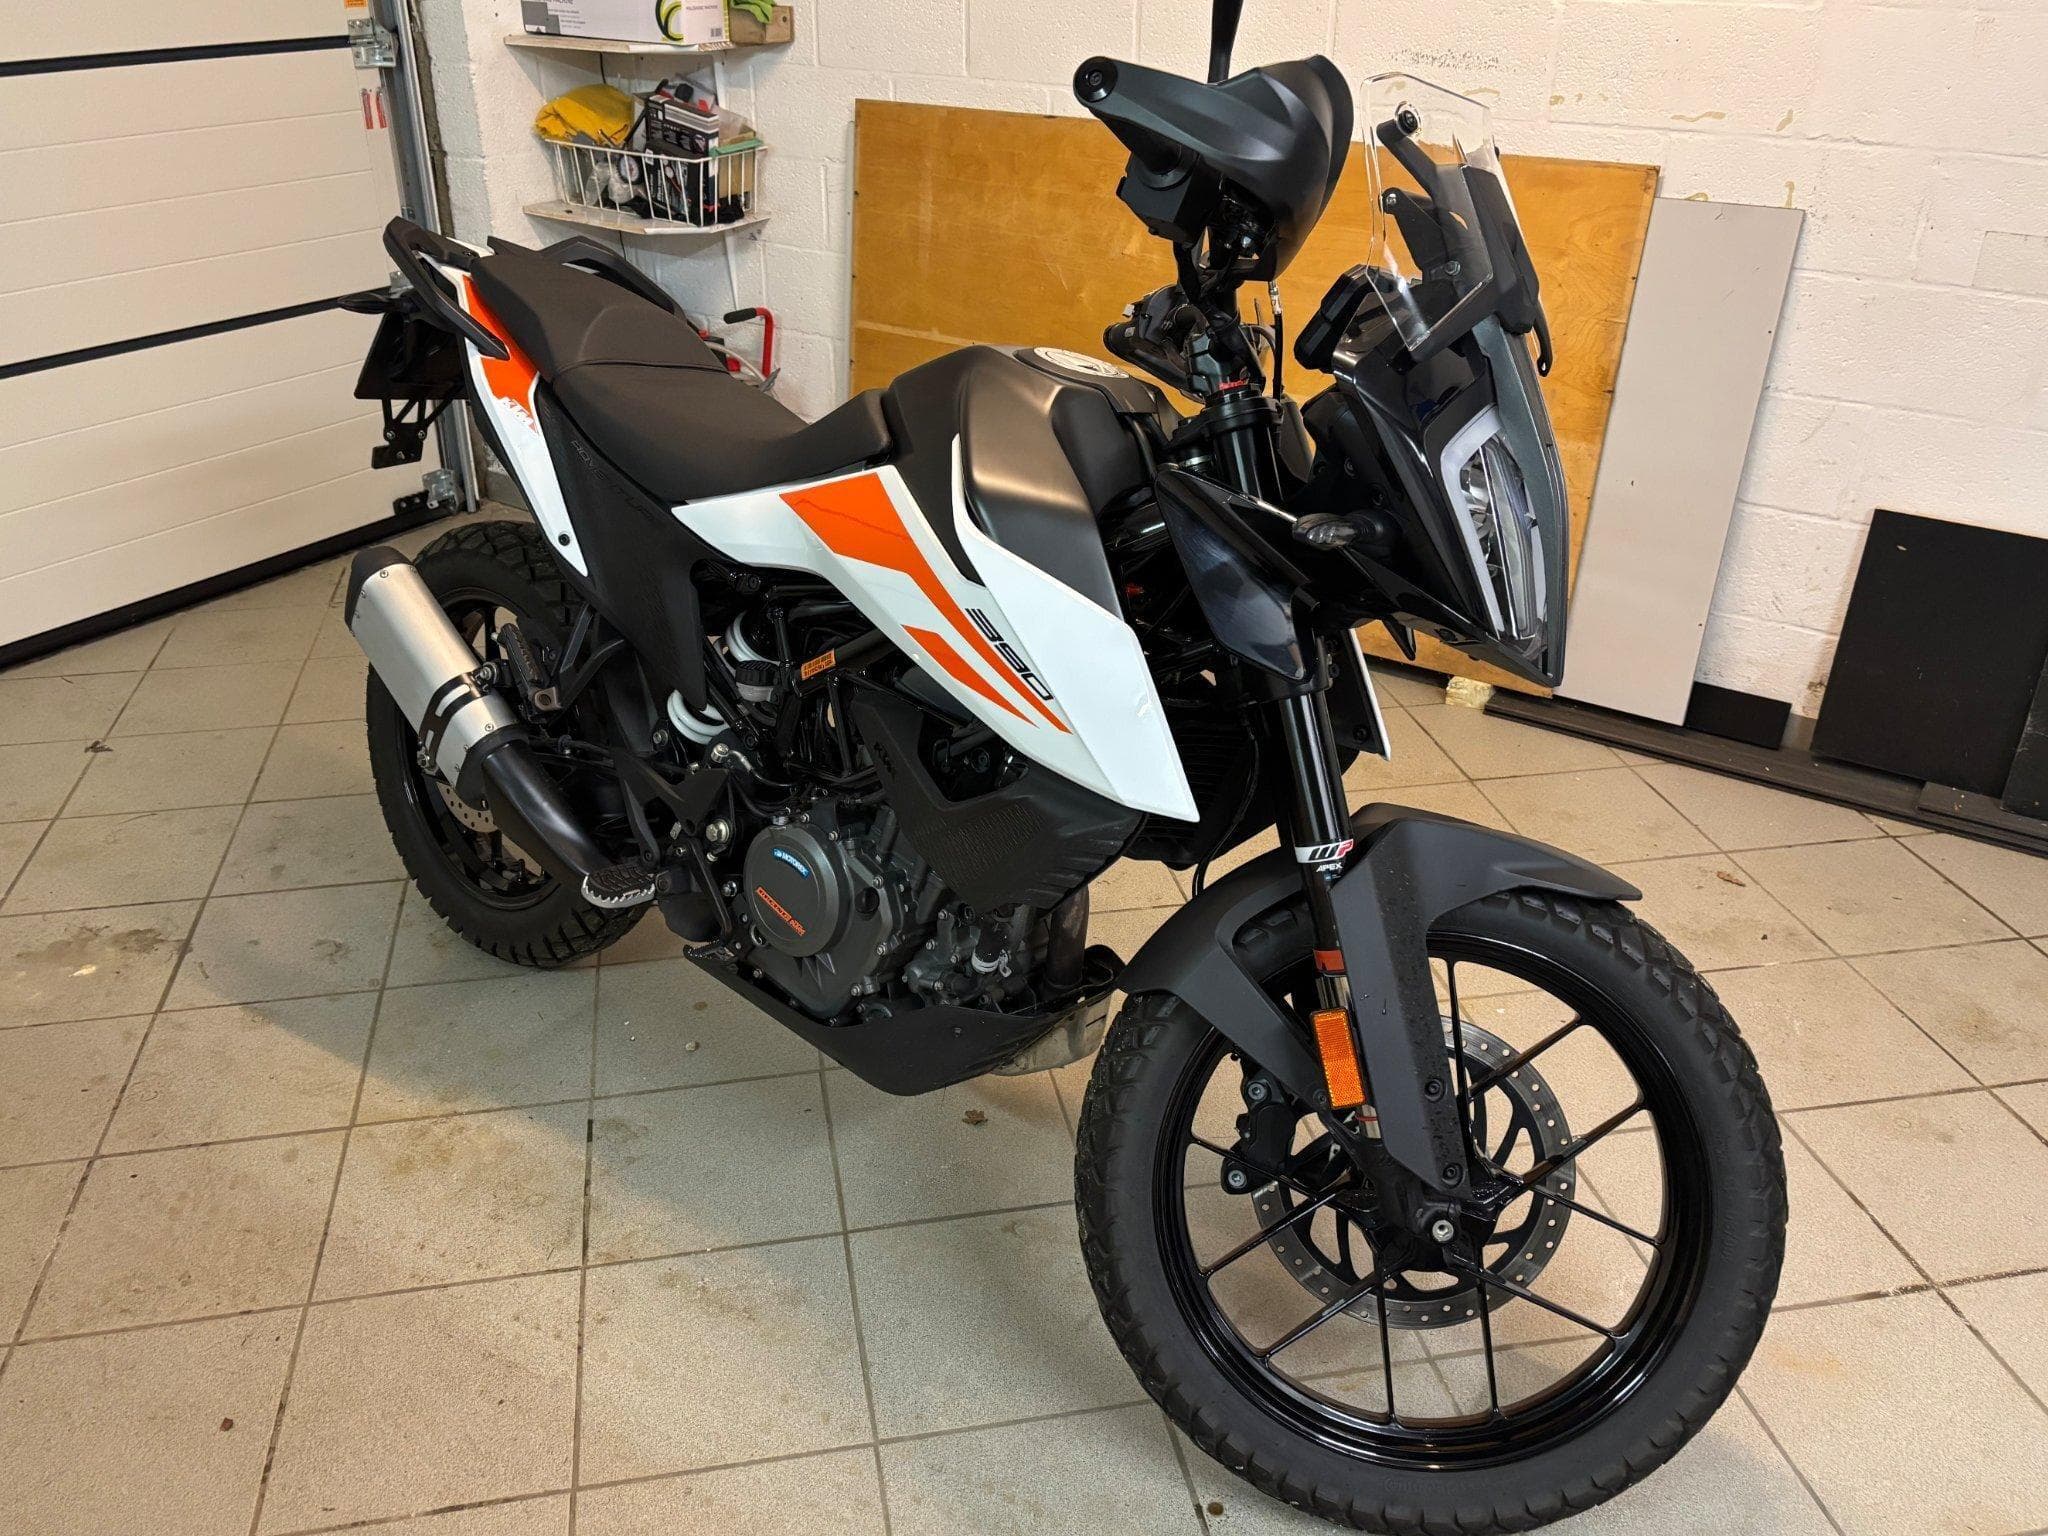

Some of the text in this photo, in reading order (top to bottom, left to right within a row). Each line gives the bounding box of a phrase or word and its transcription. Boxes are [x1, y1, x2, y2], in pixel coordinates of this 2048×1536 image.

[964, 608, 1054, 701] 390
[1308, 839, 1353, 861] WP
[781, 853, 809, 877] MOTOREX
[1316, 862, 1343, 872] APEX
